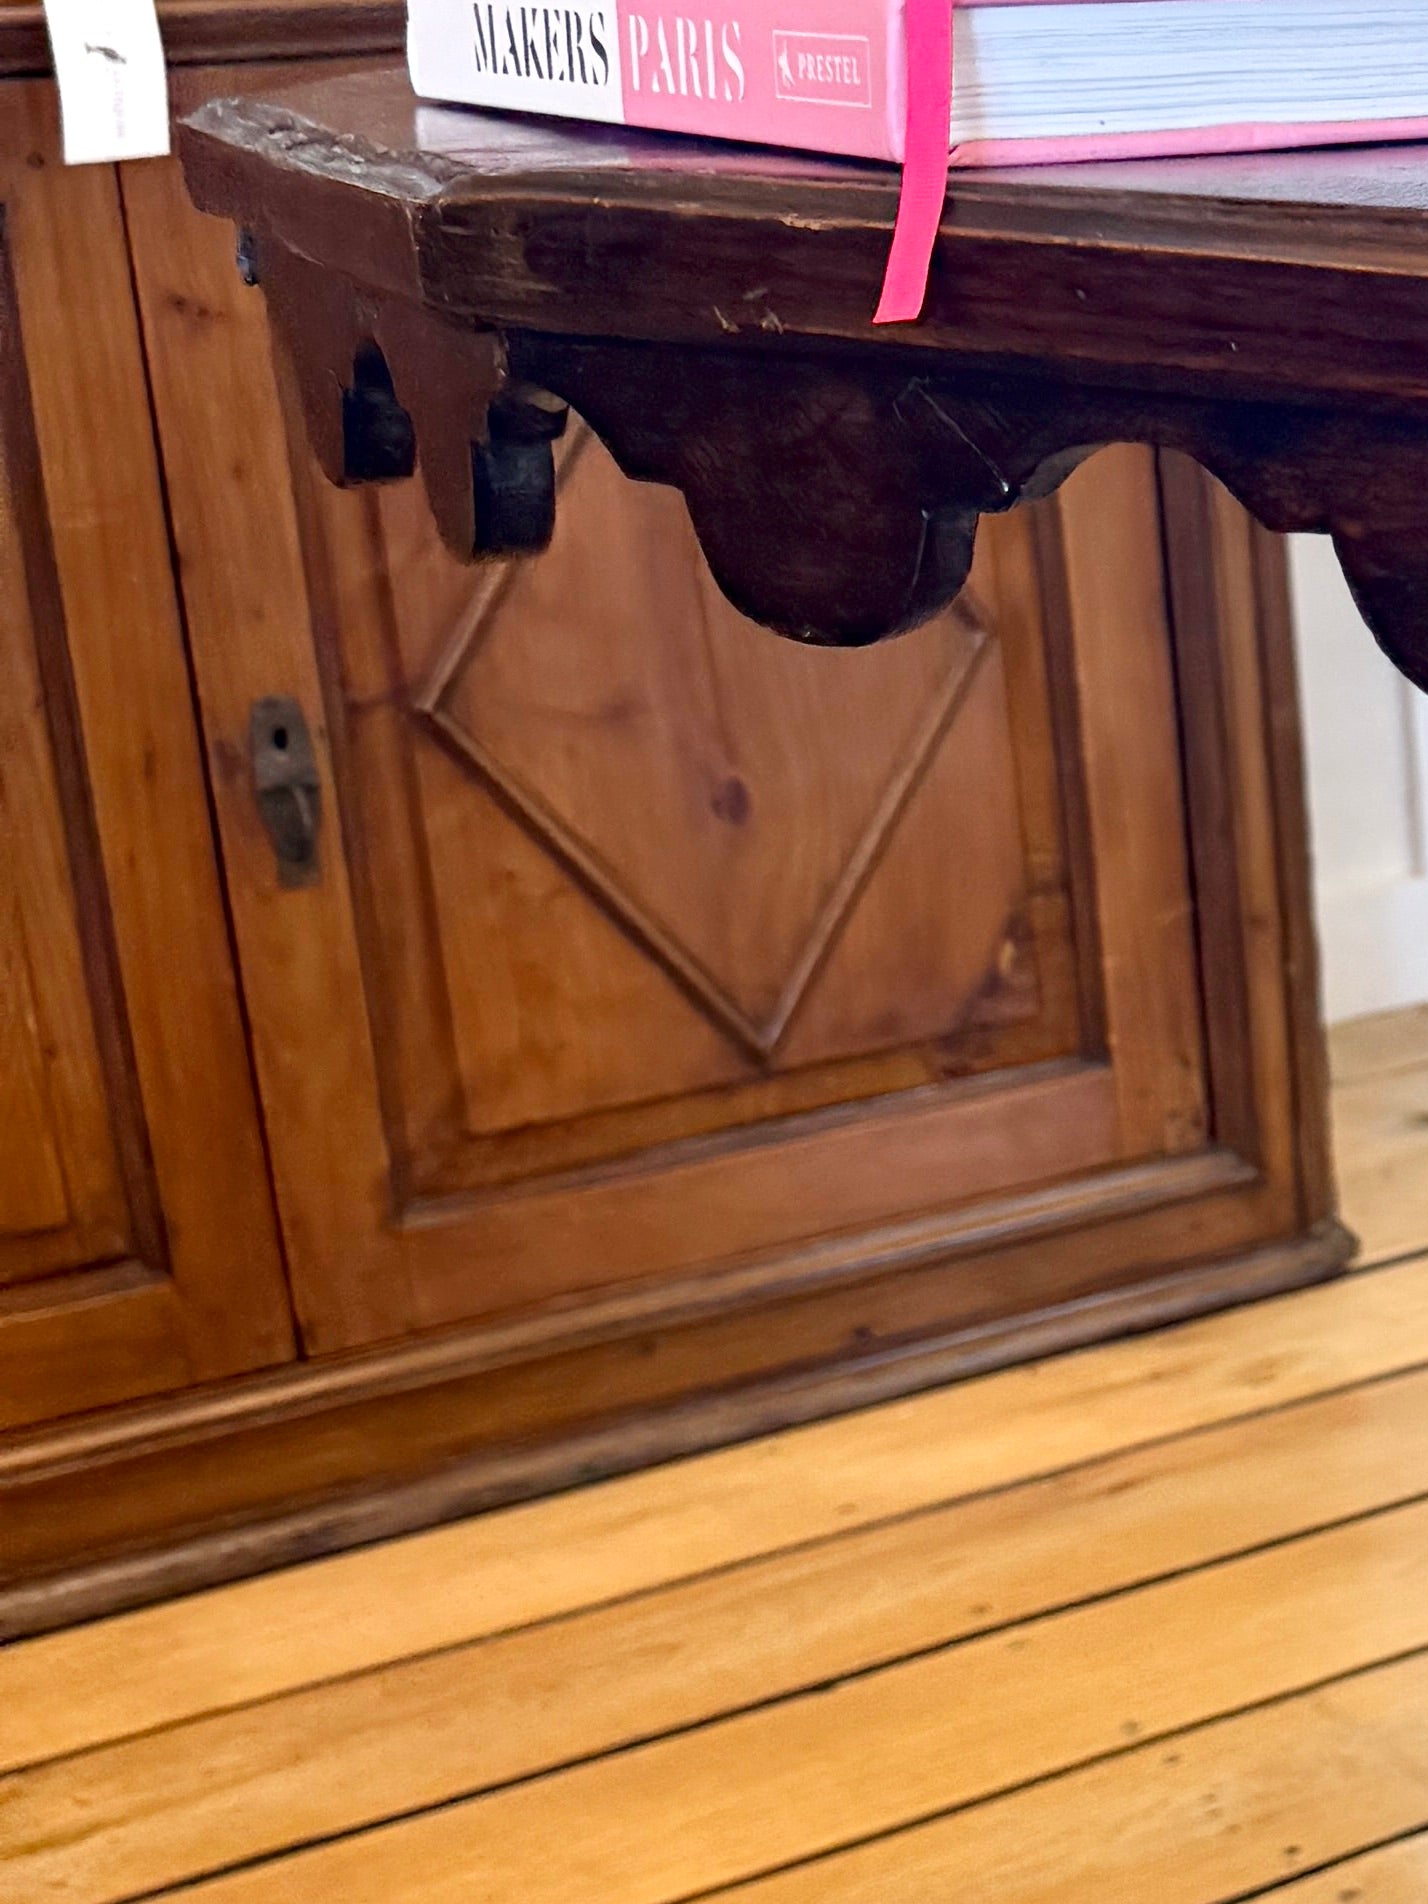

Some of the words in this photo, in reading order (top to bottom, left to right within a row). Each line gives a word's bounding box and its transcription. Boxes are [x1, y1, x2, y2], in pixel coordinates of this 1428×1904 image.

[473, 3, 609, 86] MAKERS
[629, 14, 745, 103] PARIS
[797, 52, 862, 86] PRESTEL
